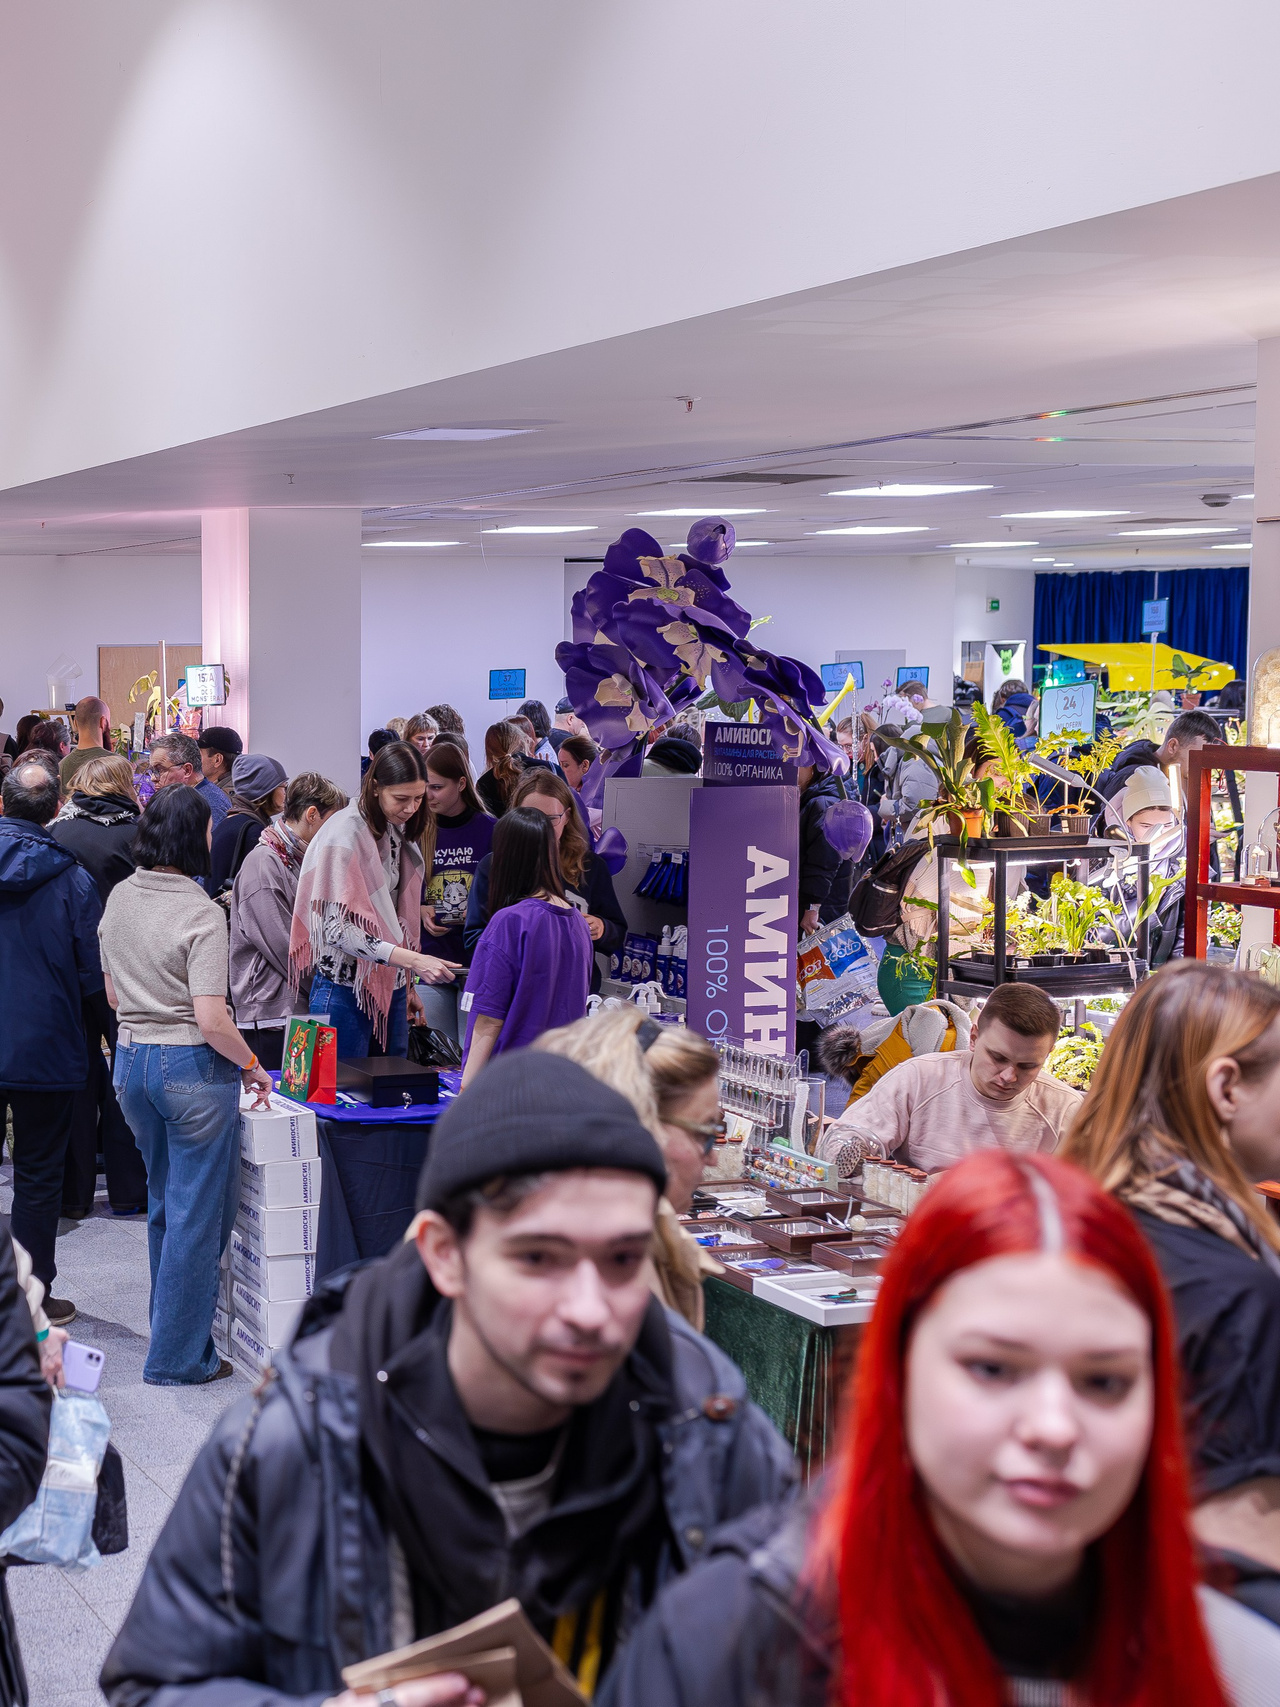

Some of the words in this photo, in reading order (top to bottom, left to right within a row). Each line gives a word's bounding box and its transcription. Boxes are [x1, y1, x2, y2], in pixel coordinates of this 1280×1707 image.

[1063, 696, 1076, 710] 24
[715, 727, 772, 745] АМИНОСИ
[742, 749, 755, 758] ДЛЯ
[714, 762, 732, 776] 100%
[735, 763, 784, 780] ОРГАНИКА
[434, 847, 473, 858] КУЧАЮ
[744, 846, 790, 1057] АМИН
[829, 941, 862, 963] COLD
[706, 924, 729, 999] 100%
[800, 960, 822, 980] HOT
[290, 1116, 298, 1157] АМИНОСИЛ
